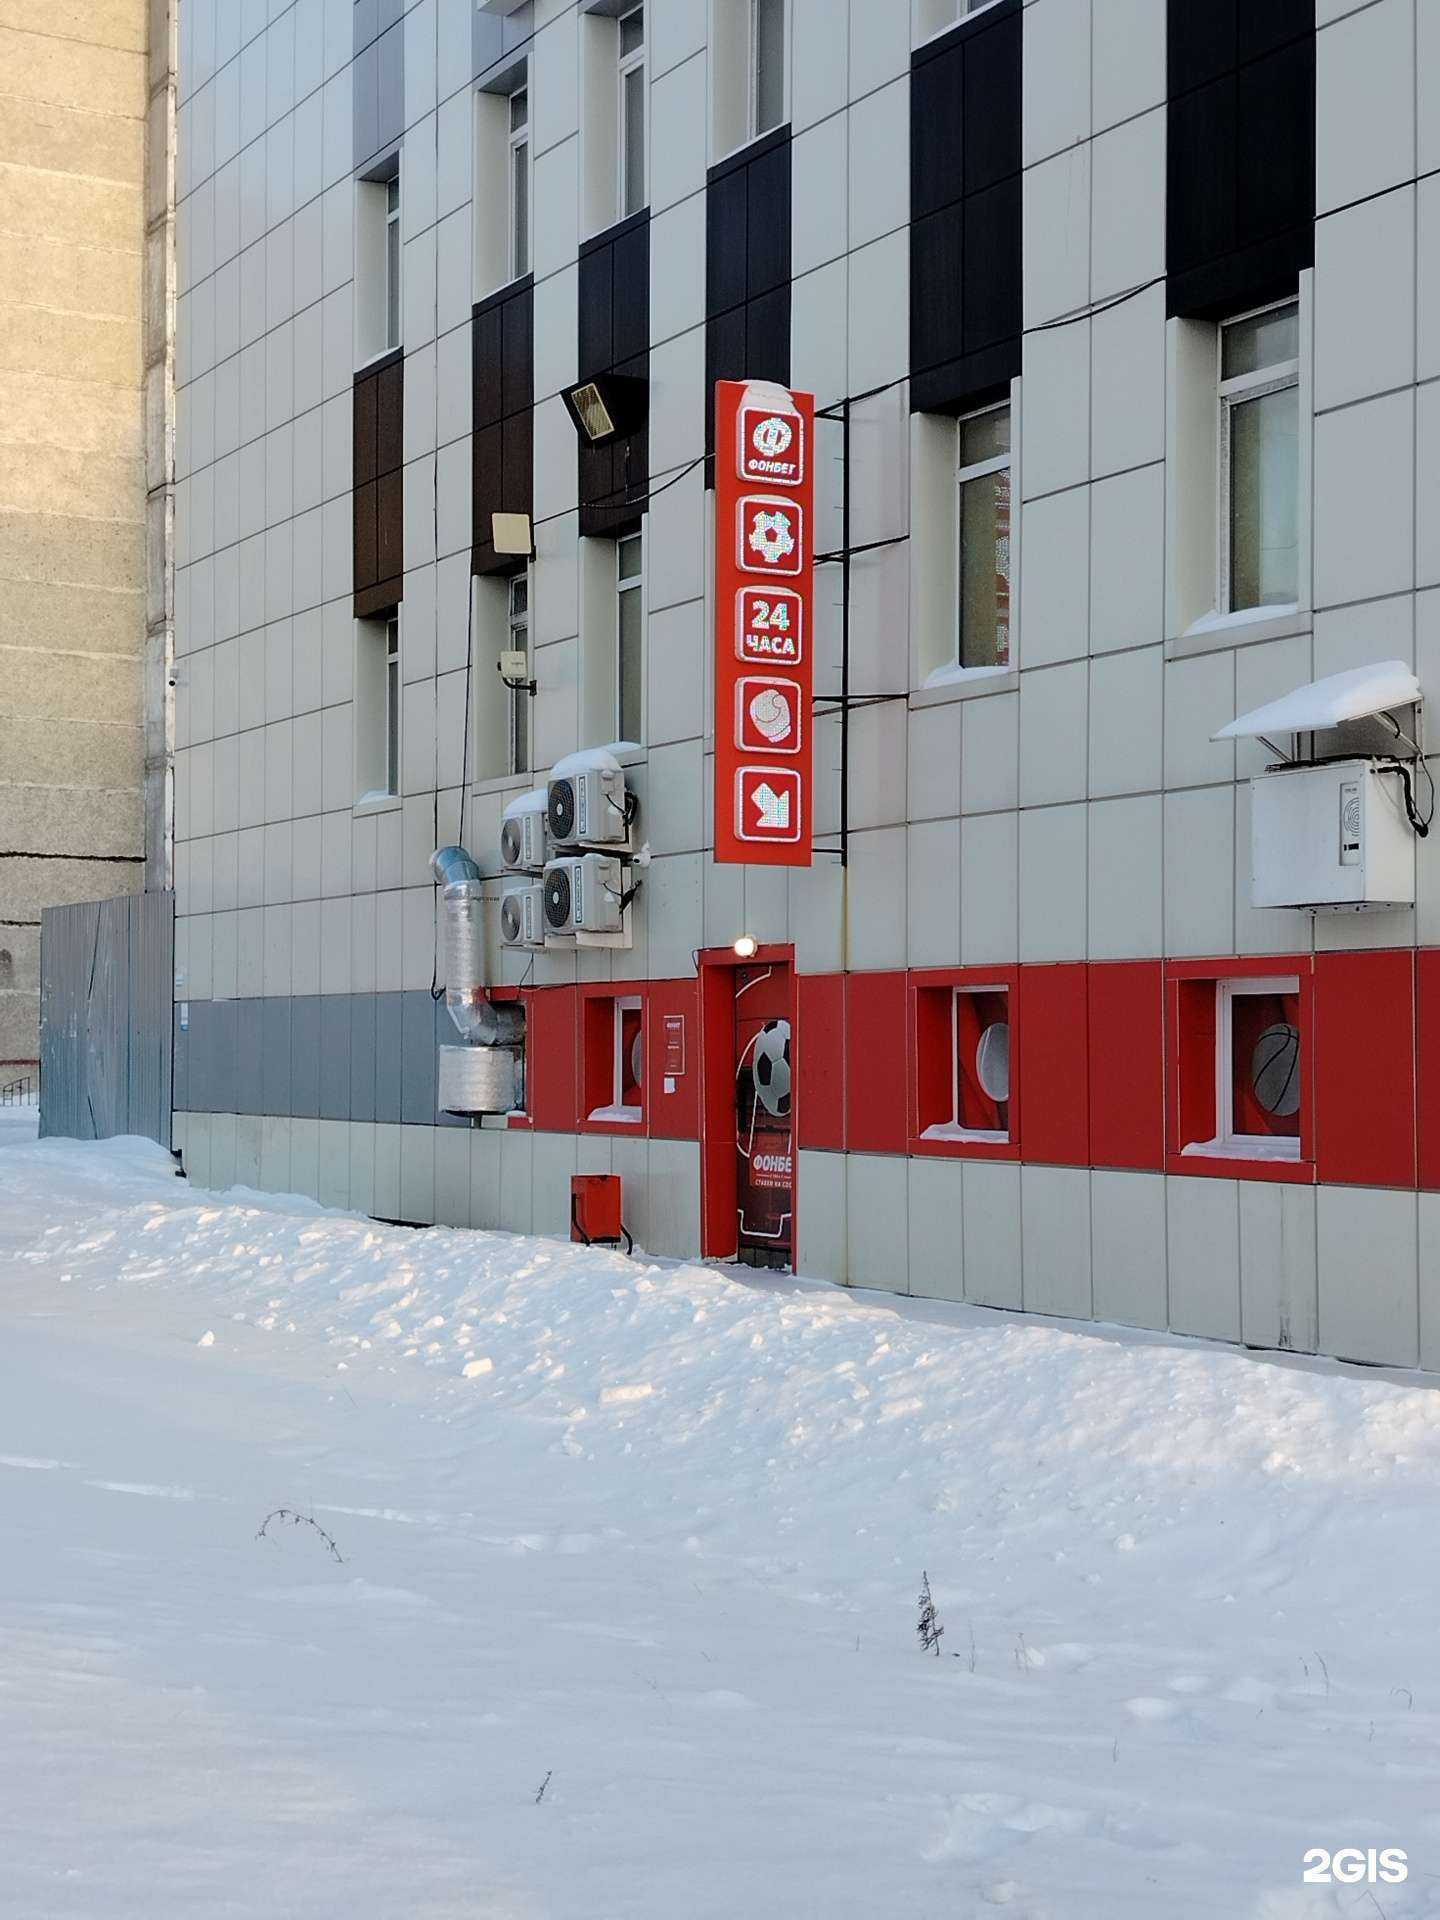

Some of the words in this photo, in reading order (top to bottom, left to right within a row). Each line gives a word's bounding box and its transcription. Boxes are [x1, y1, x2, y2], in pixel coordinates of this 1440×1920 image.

[748, 459, 797, 475] ФОНБЕТ
[752, 600, 790, 630] 24
[746, 634, 796, 655] ЧАСА
